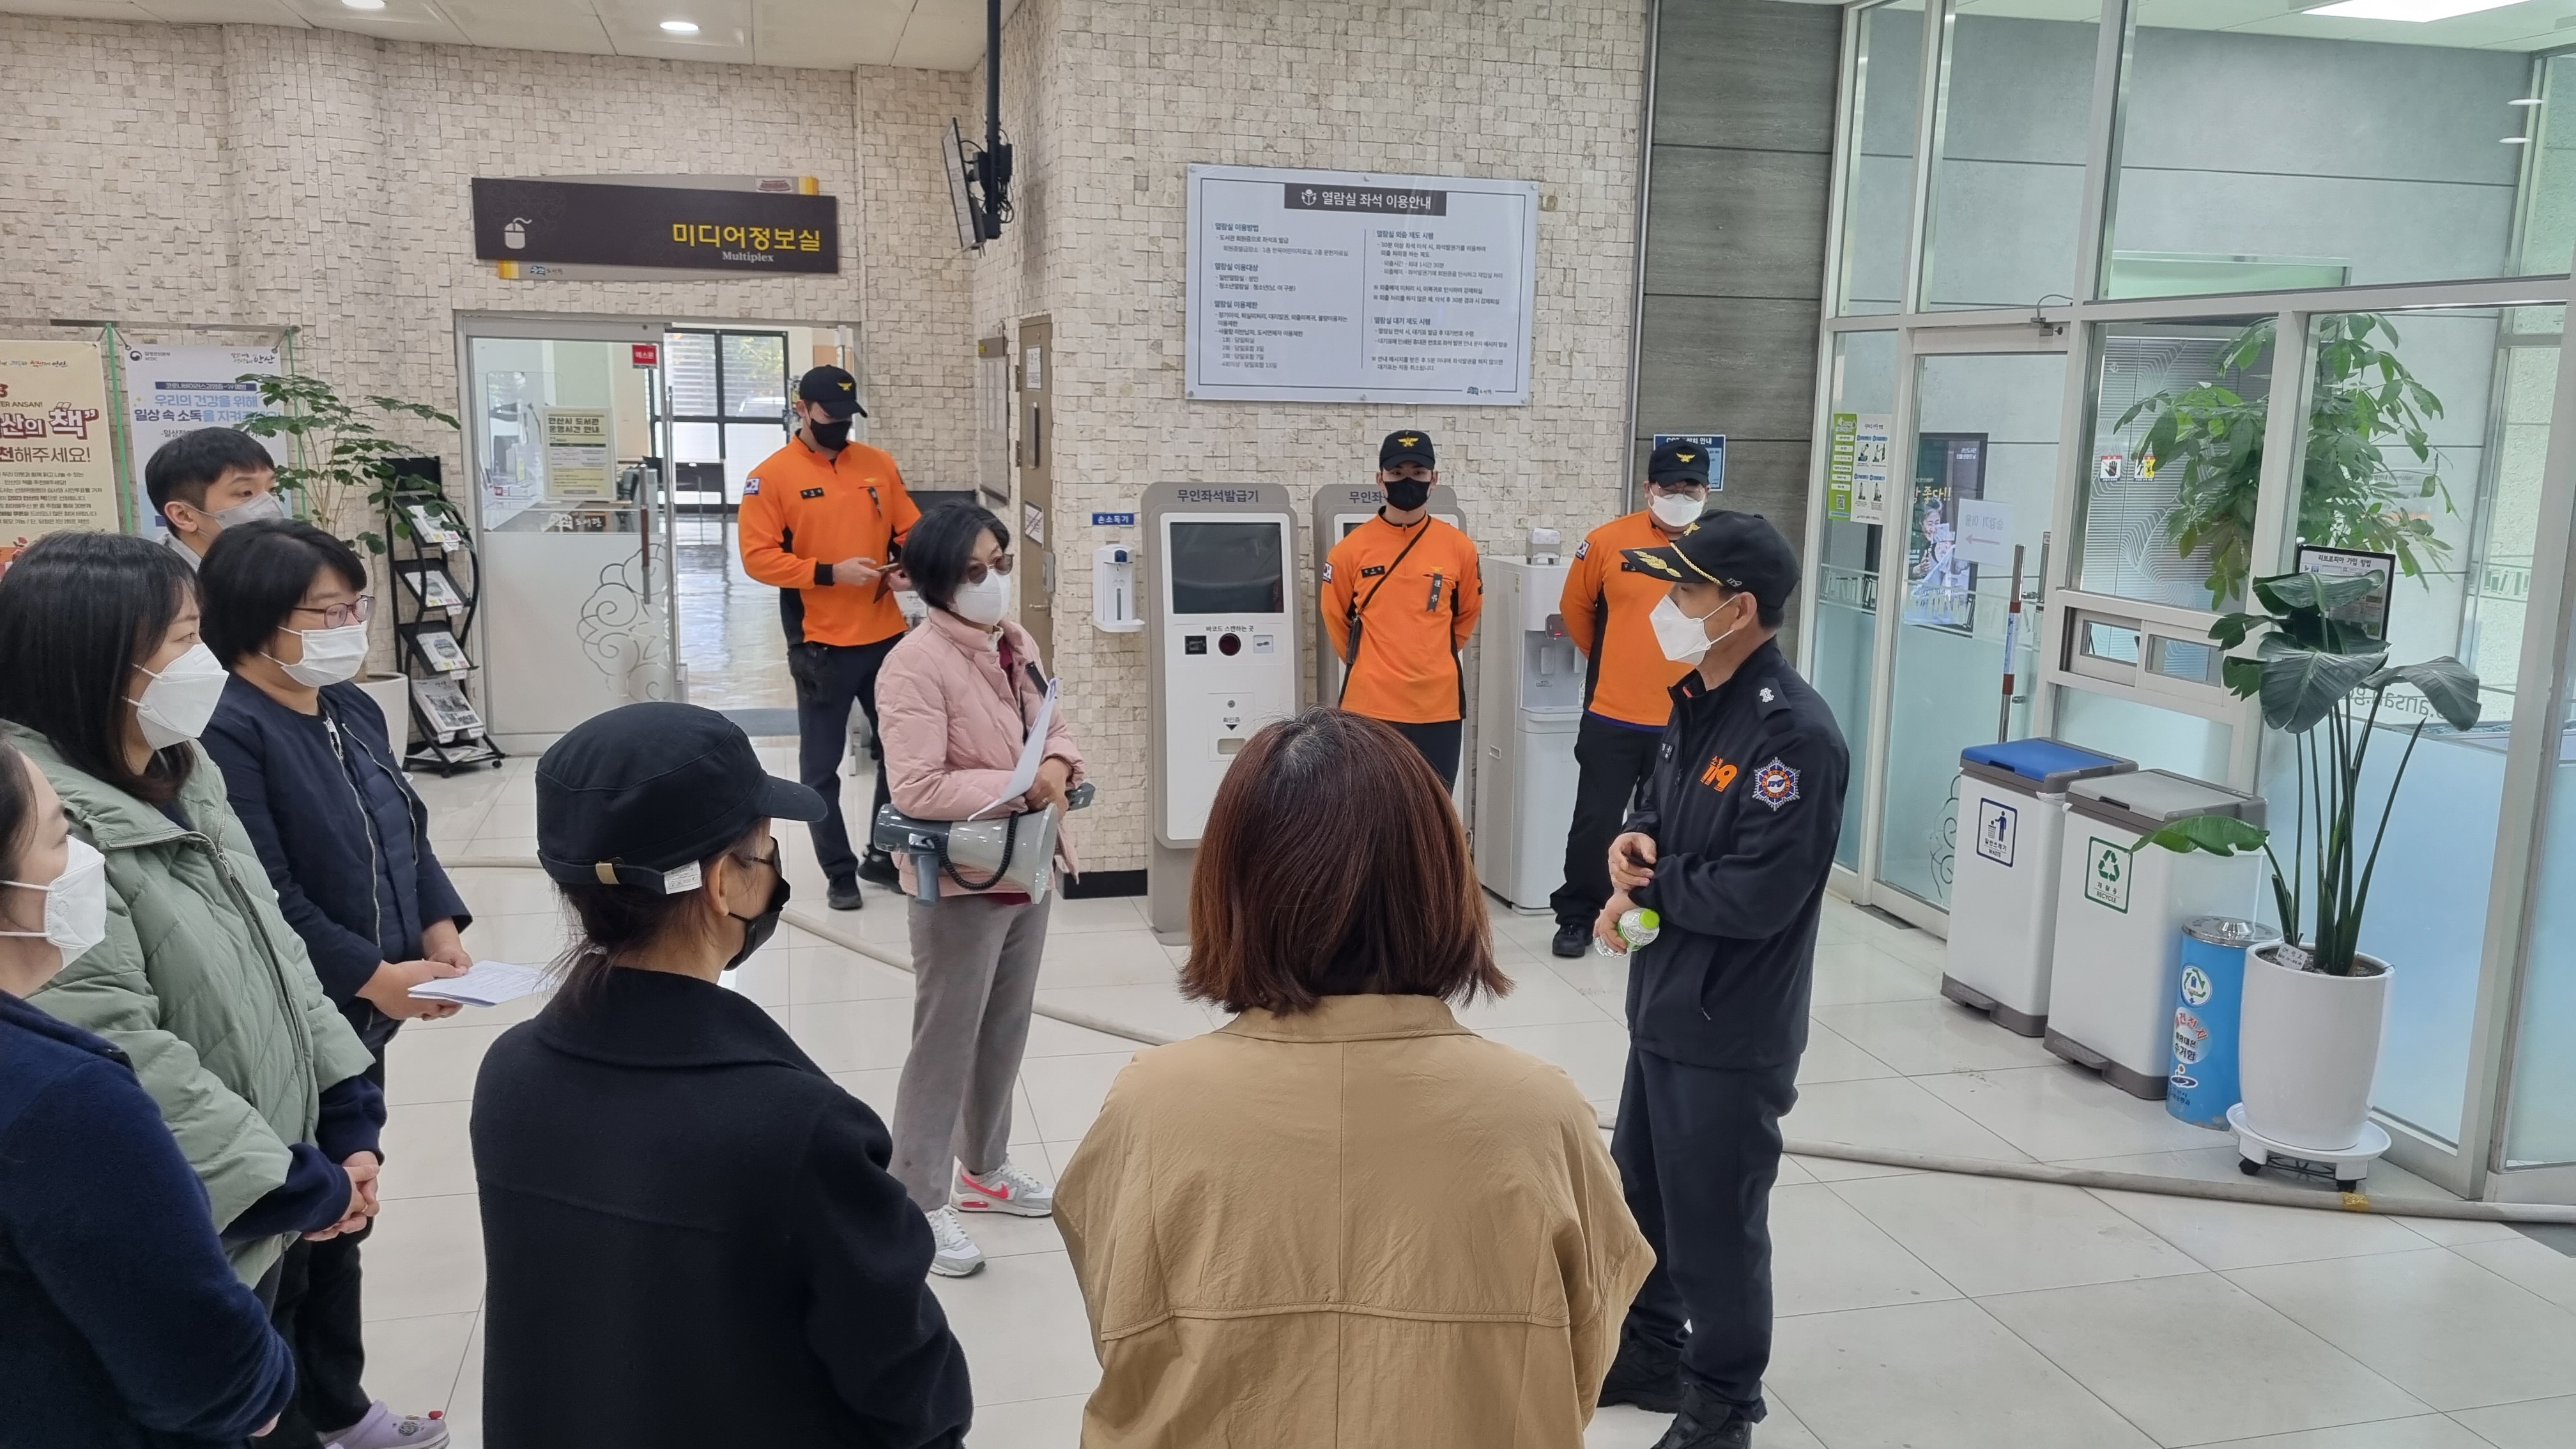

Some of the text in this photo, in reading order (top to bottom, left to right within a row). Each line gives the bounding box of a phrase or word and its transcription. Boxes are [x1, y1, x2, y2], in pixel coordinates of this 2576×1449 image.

[1322, 191, 1431, 210] 열람실 좌석 이용안내
[1215, 223, 1259, 232] 열람실 이용방법
[673, 224, 821, 252] 미디어정보실
[1376, 230, 1394, 238] 열람실
[722, 251, 774, 263] Multiplex
[1215, 263, 1259, 272] 열람실 이용대상
[1233, 301, 1258, 309] 이용제한
[1374, 317, 1392, 325] 열람실
[155, 394, 258, 408] 우리의 건강을 위해
[134, 409, 215, 422] 일상 속 소독을
[1177, 489, 1259, 503] 무인좌석발급기
[1098, 516, 1129, 524] 손소독기
[2318, 555, 2372, 567] 리브로피아 가입 방법
[1701, 764, 1738, 792] 119
[1984, 838, 2007, 852] 일반쓰레기
[1988, 848, 2001, 858] WASTE
[2096, 891, 2117, 904] RECYCLE
[2174, 1042, 2196, 1062] 수거함
